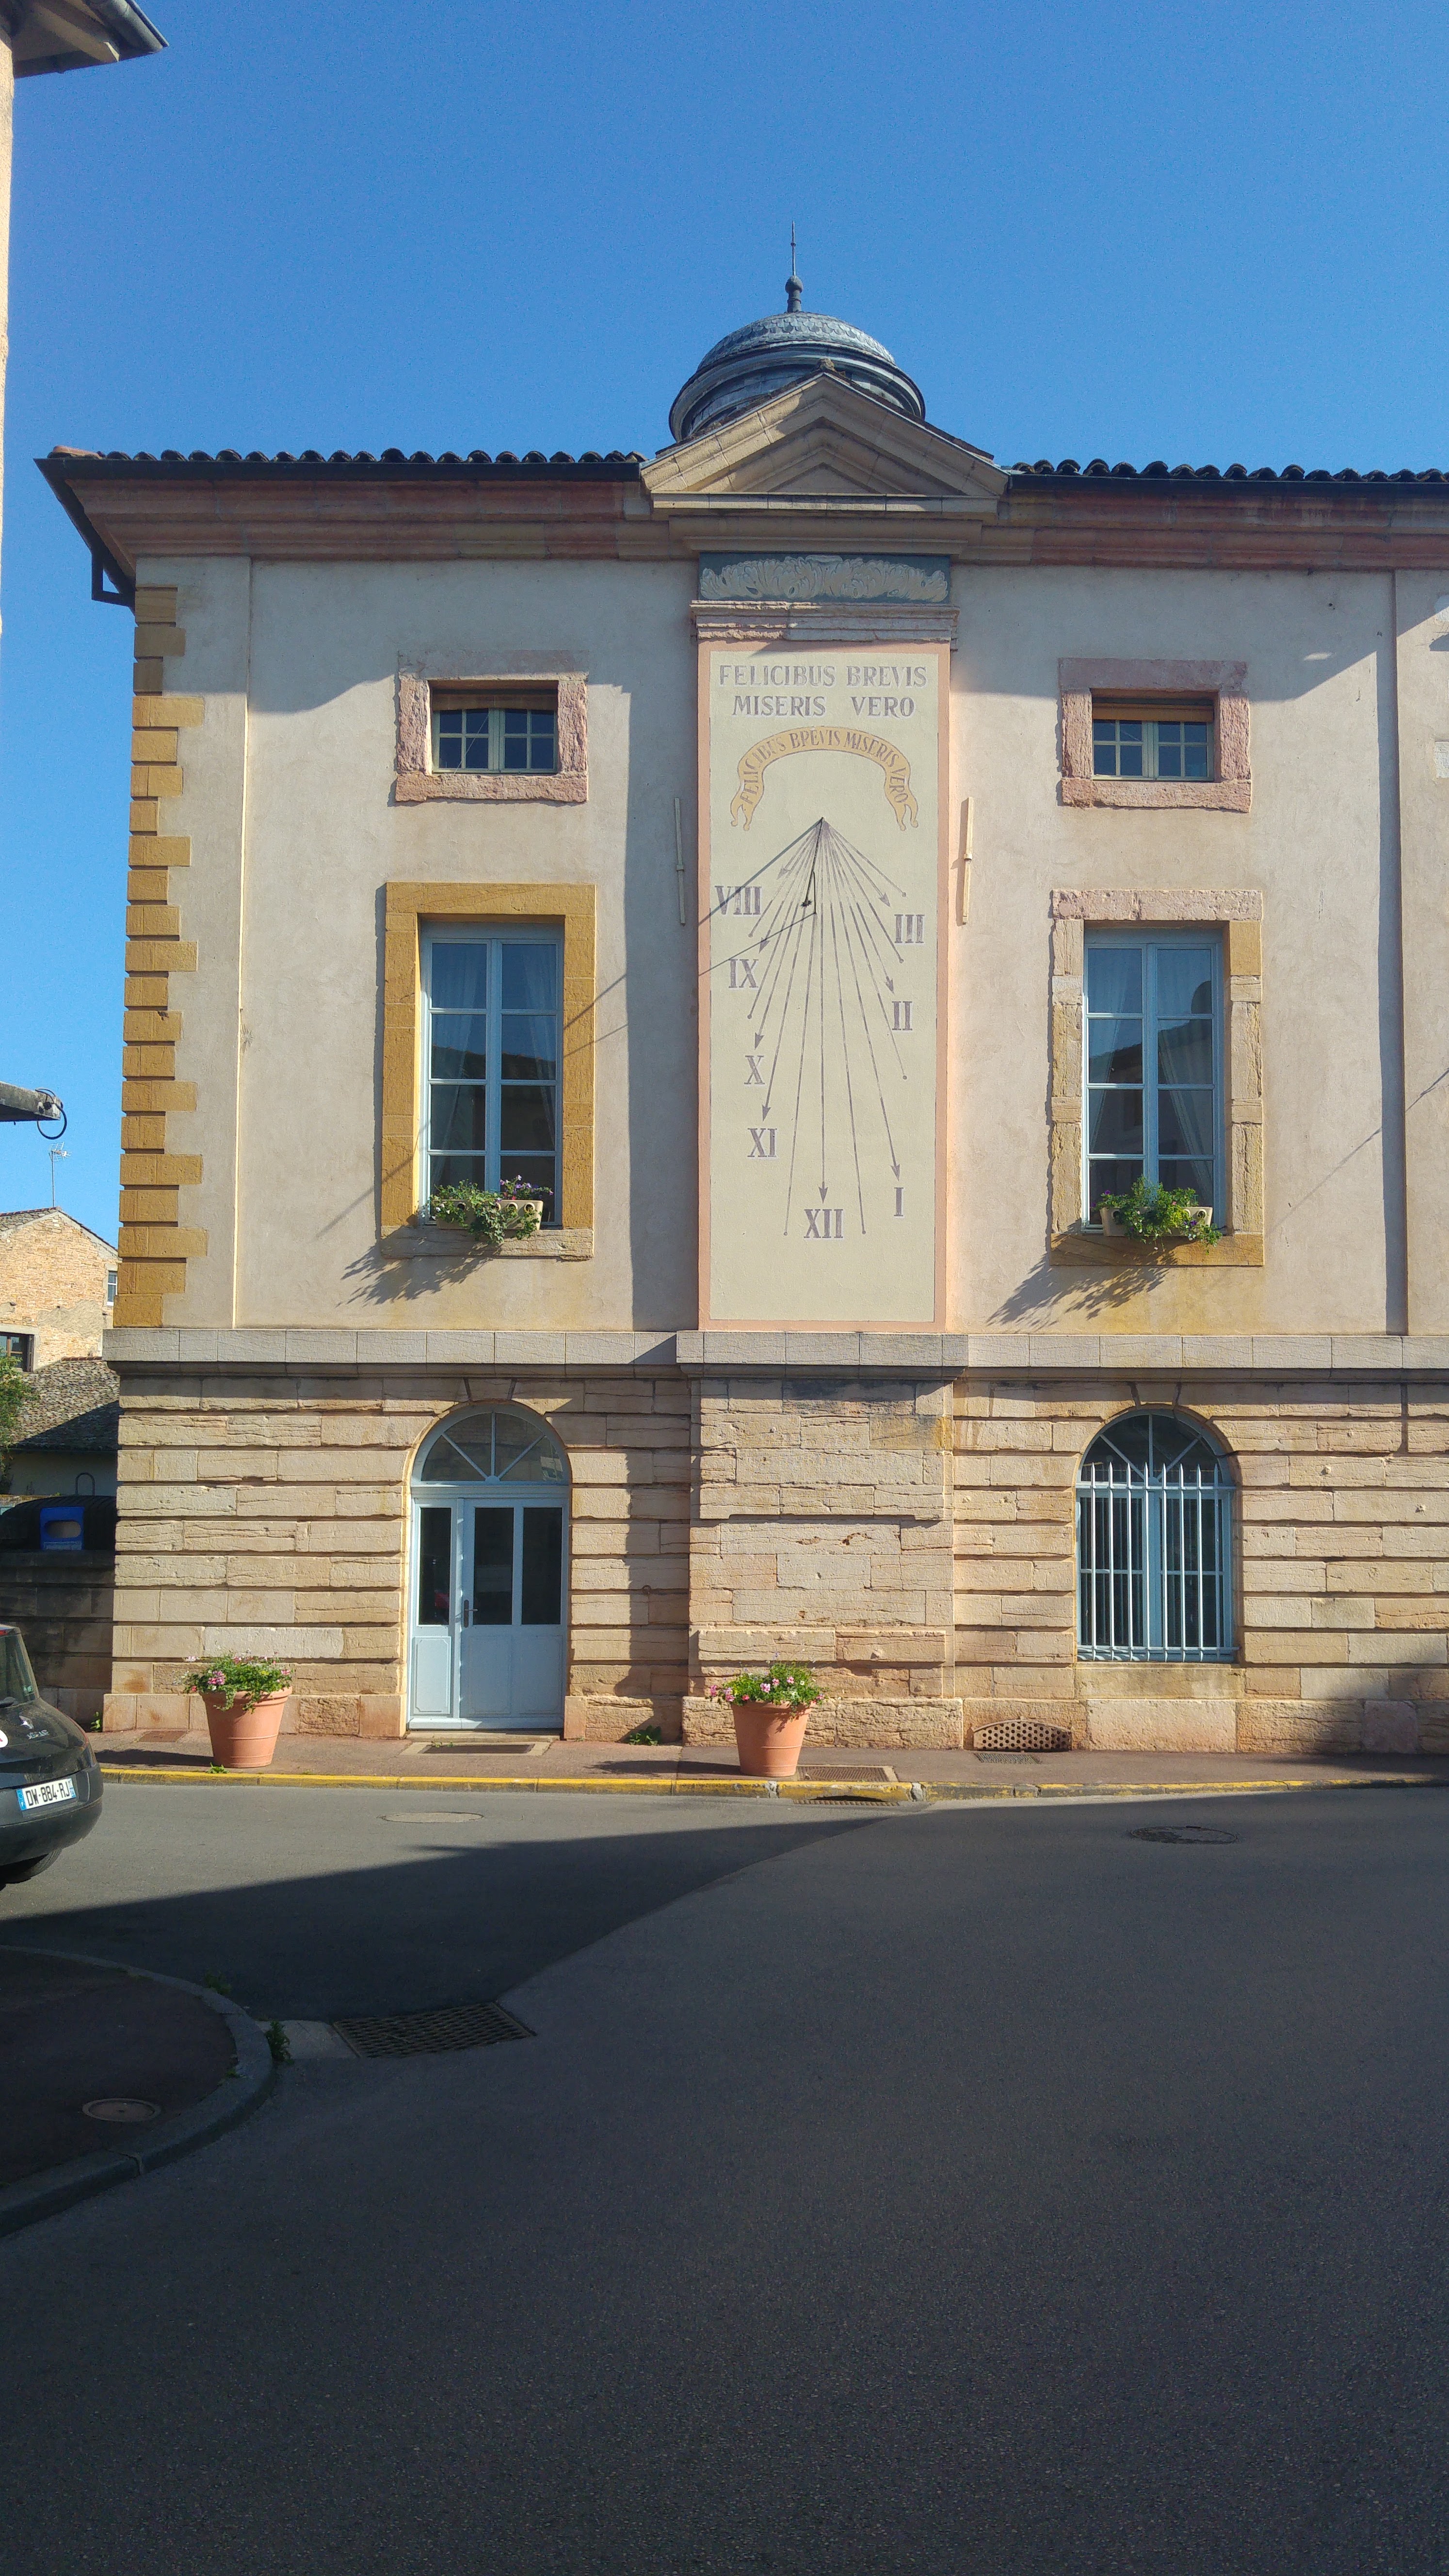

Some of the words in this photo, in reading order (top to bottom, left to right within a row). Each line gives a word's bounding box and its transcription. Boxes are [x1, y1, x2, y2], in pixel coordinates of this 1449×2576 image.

[719, 665, 836, 687] FELICIBUS
[846, 666, 927, 688] BREVIS
[731, 695, 826, 718] MISERIS
[852, 696, 915, 718] VERO
[843, 731, 900, 767] MISERIS
[889, 767, 908, 803] VERO
[714, 886, 762, 915] VIII
[894, 914, 925, 944] III
[728, 959, 759, 988] IX
[891, 1001, 913, 1031] II
[744, 1055, 765, 1085] X
[747, 1128, 777, 1158] XI
[894, 1187, 904, 1217] I
[804, 1209, 843, 1239] XII
